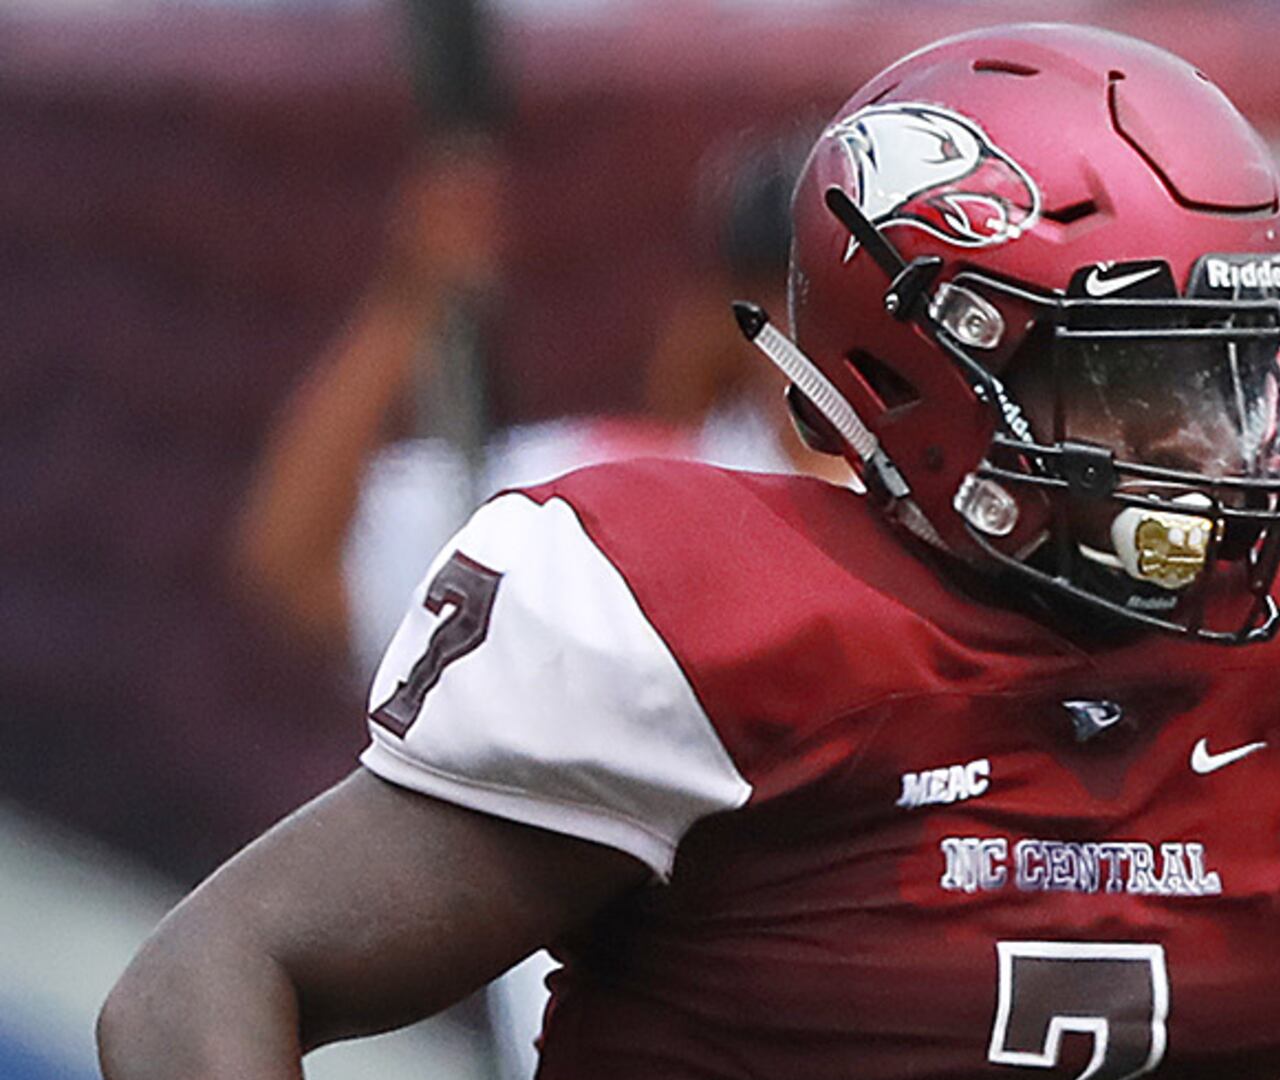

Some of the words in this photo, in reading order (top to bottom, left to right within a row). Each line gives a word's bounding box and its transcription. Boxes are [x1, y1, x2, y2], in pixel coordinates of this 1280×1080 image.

[369, 549, 505, 740] 7
[895, 759, 990, 809] MEAC
[940, 838, 1008, 893] NC
[1014, 839, 1223, 896] CENTRAL
